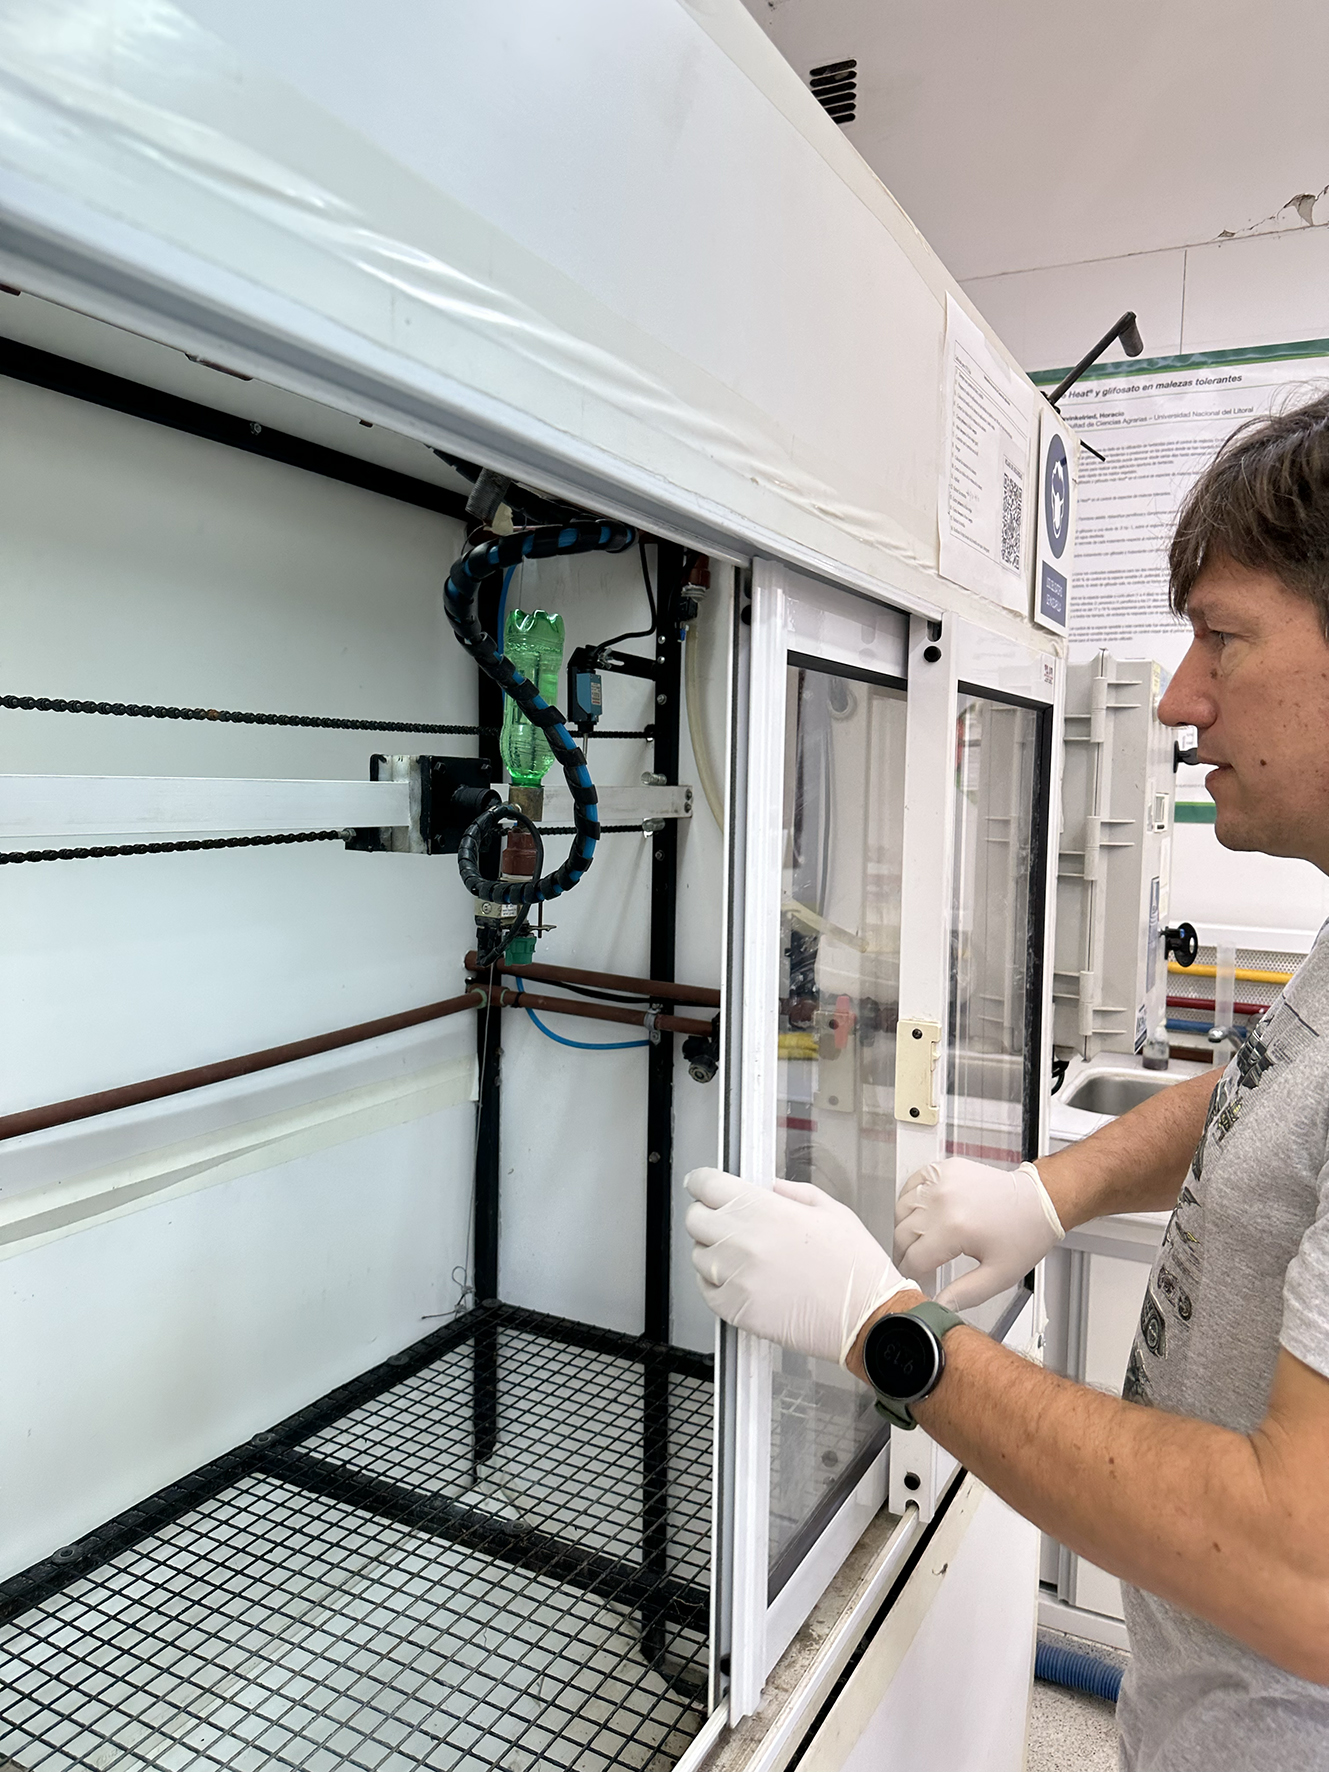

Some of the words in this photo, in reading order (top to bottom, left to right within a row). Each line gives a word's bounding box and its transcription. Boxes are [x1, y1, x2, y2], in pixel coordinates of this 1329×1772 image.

[1095, 389, 1100, 398] y
[1102, 385, 1140, 397] glifosato
[1142, 383, 1153, 391] en
[1155, 380, 1193, 390] malezas
[1195, 375, 1242, 386] tolerantes
[1095, 419, 1121, 427] Ciencias
[1122, 416, 1147, 425] Agrarias
[1154, 411, 1191, 420] Universidad
[1192, 409, 1220, 417] Nacional
[1233, 406, 1254, 414] Litoral
[1100, 411, 1125, 419] Horacio
